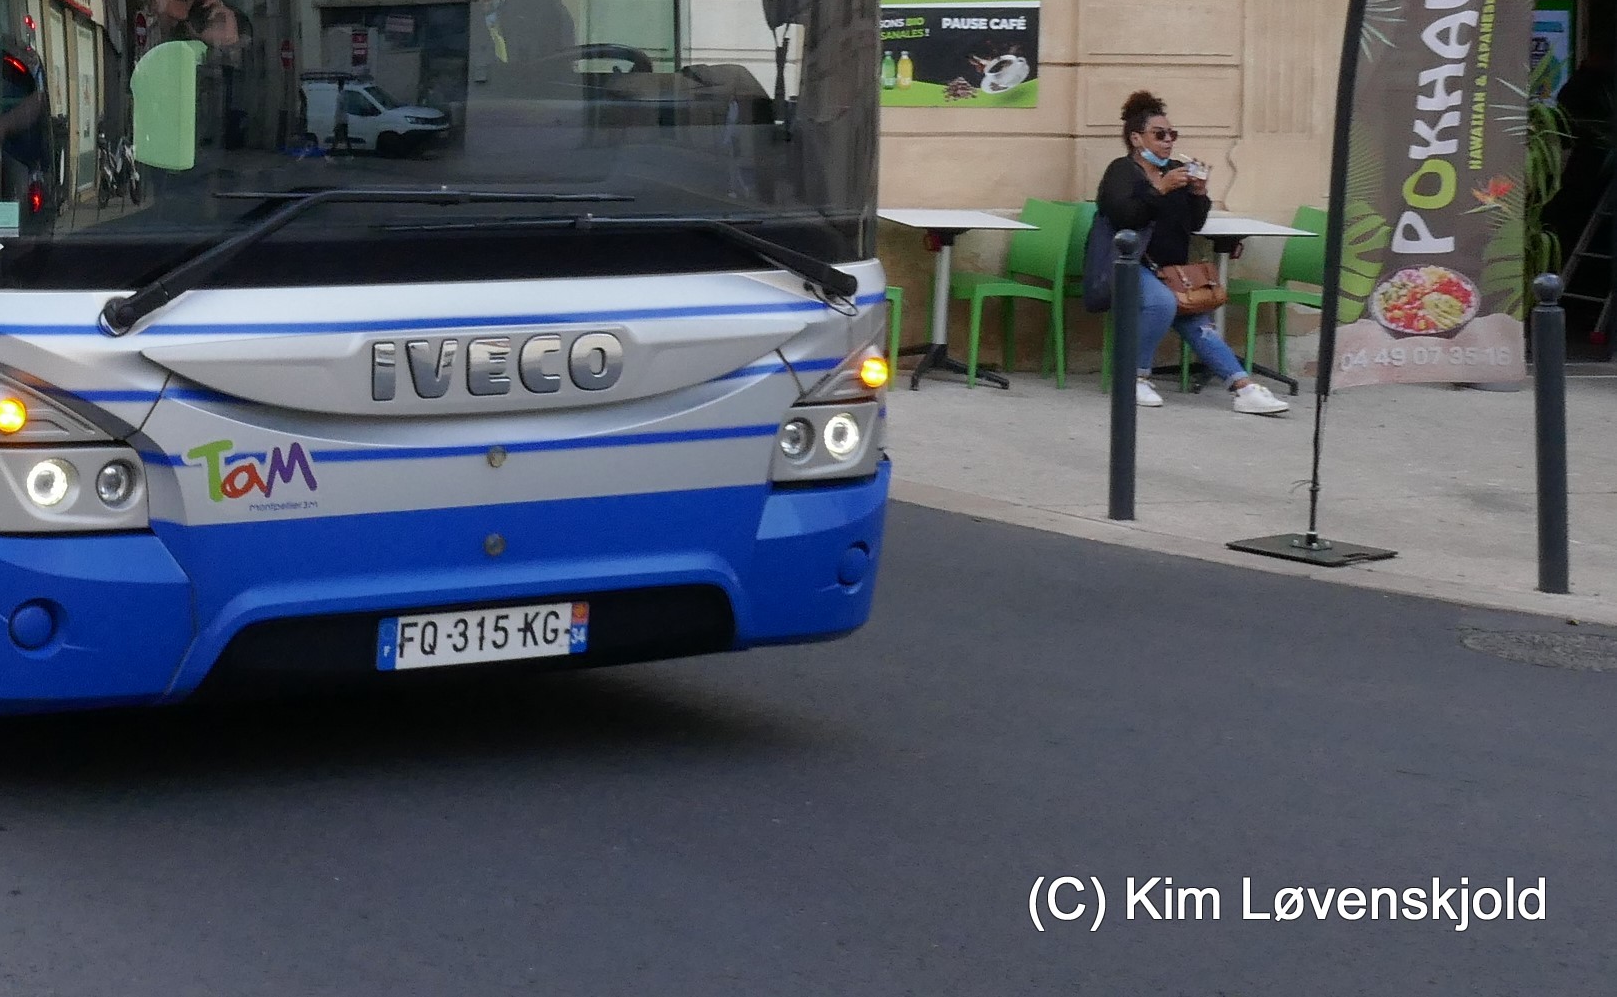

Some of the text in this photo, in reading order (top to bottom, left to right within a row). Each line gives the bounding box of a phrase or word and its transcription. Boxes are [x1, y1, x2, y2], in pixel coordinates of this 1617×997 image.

[941, 15, 1027, 30] PAUSE CAFÉ
[1469, 92, 1487, 170] HAWAIIAN
[371, 330, 624, 402] IVECO
[1340, 346, 1513, 371] 04 49 07 35 16
[571, 627, 586, 644] 34
